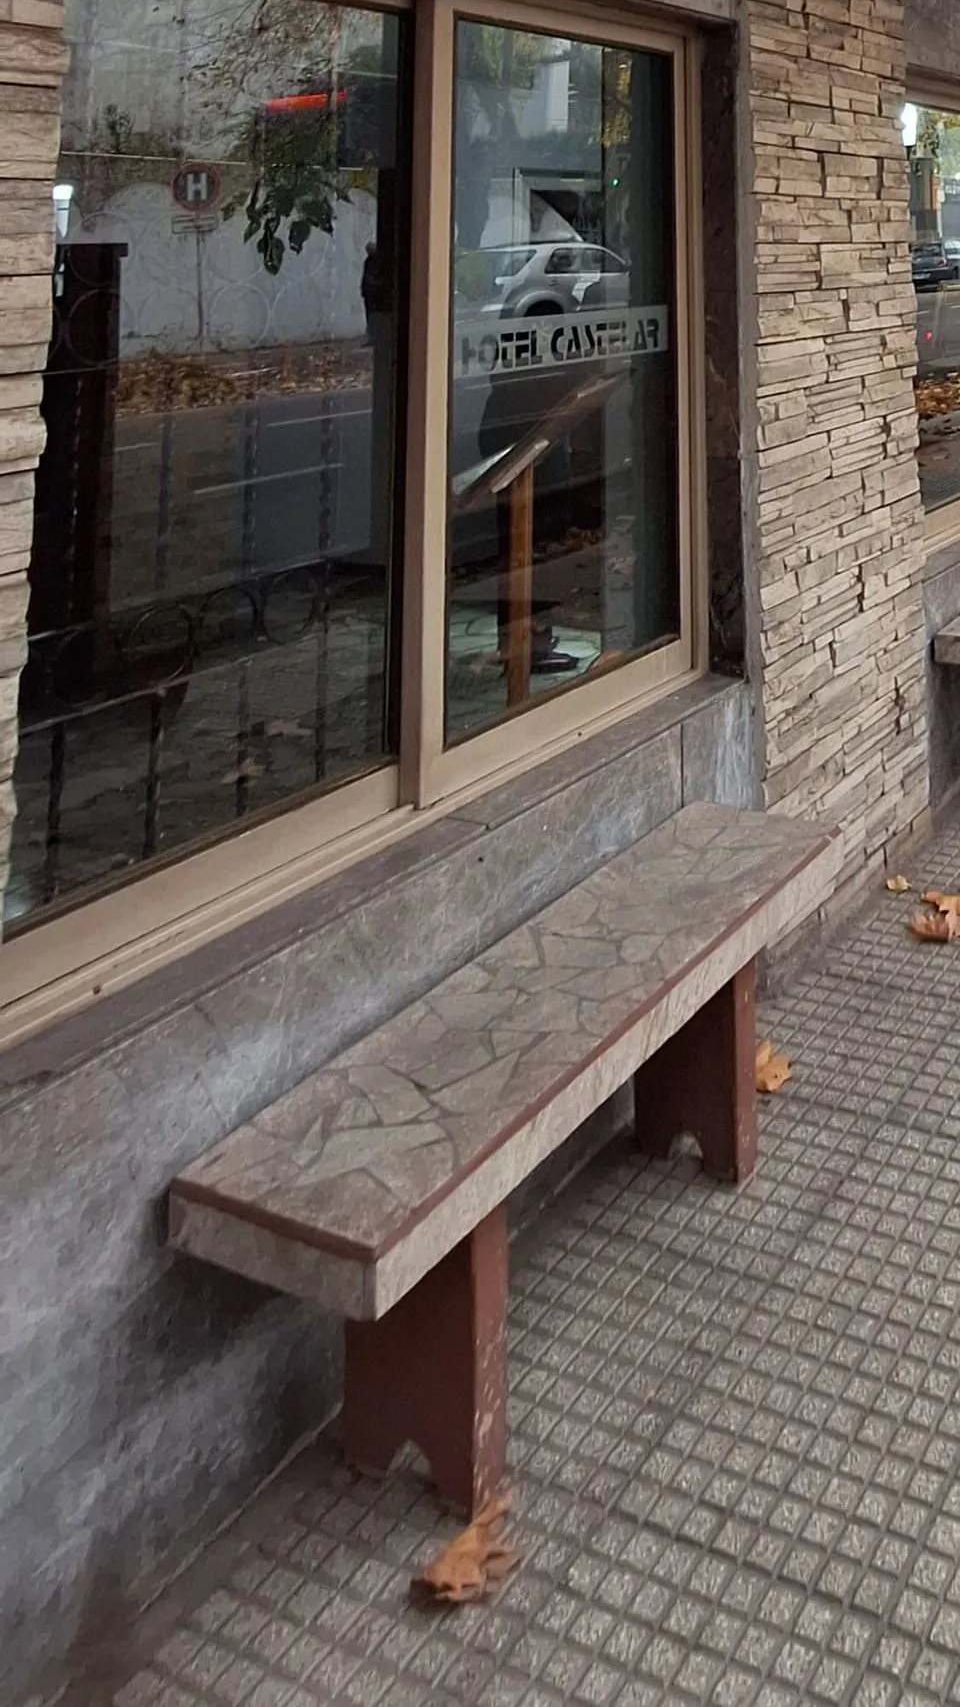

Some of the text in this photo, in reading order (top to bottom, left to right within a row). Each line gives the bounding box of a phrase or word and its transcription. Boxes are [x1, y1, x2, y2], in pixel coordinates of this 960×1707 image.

[187, 172, 208, 203] H
[461, 318, 659, 375] HOTEL CASTELAR
